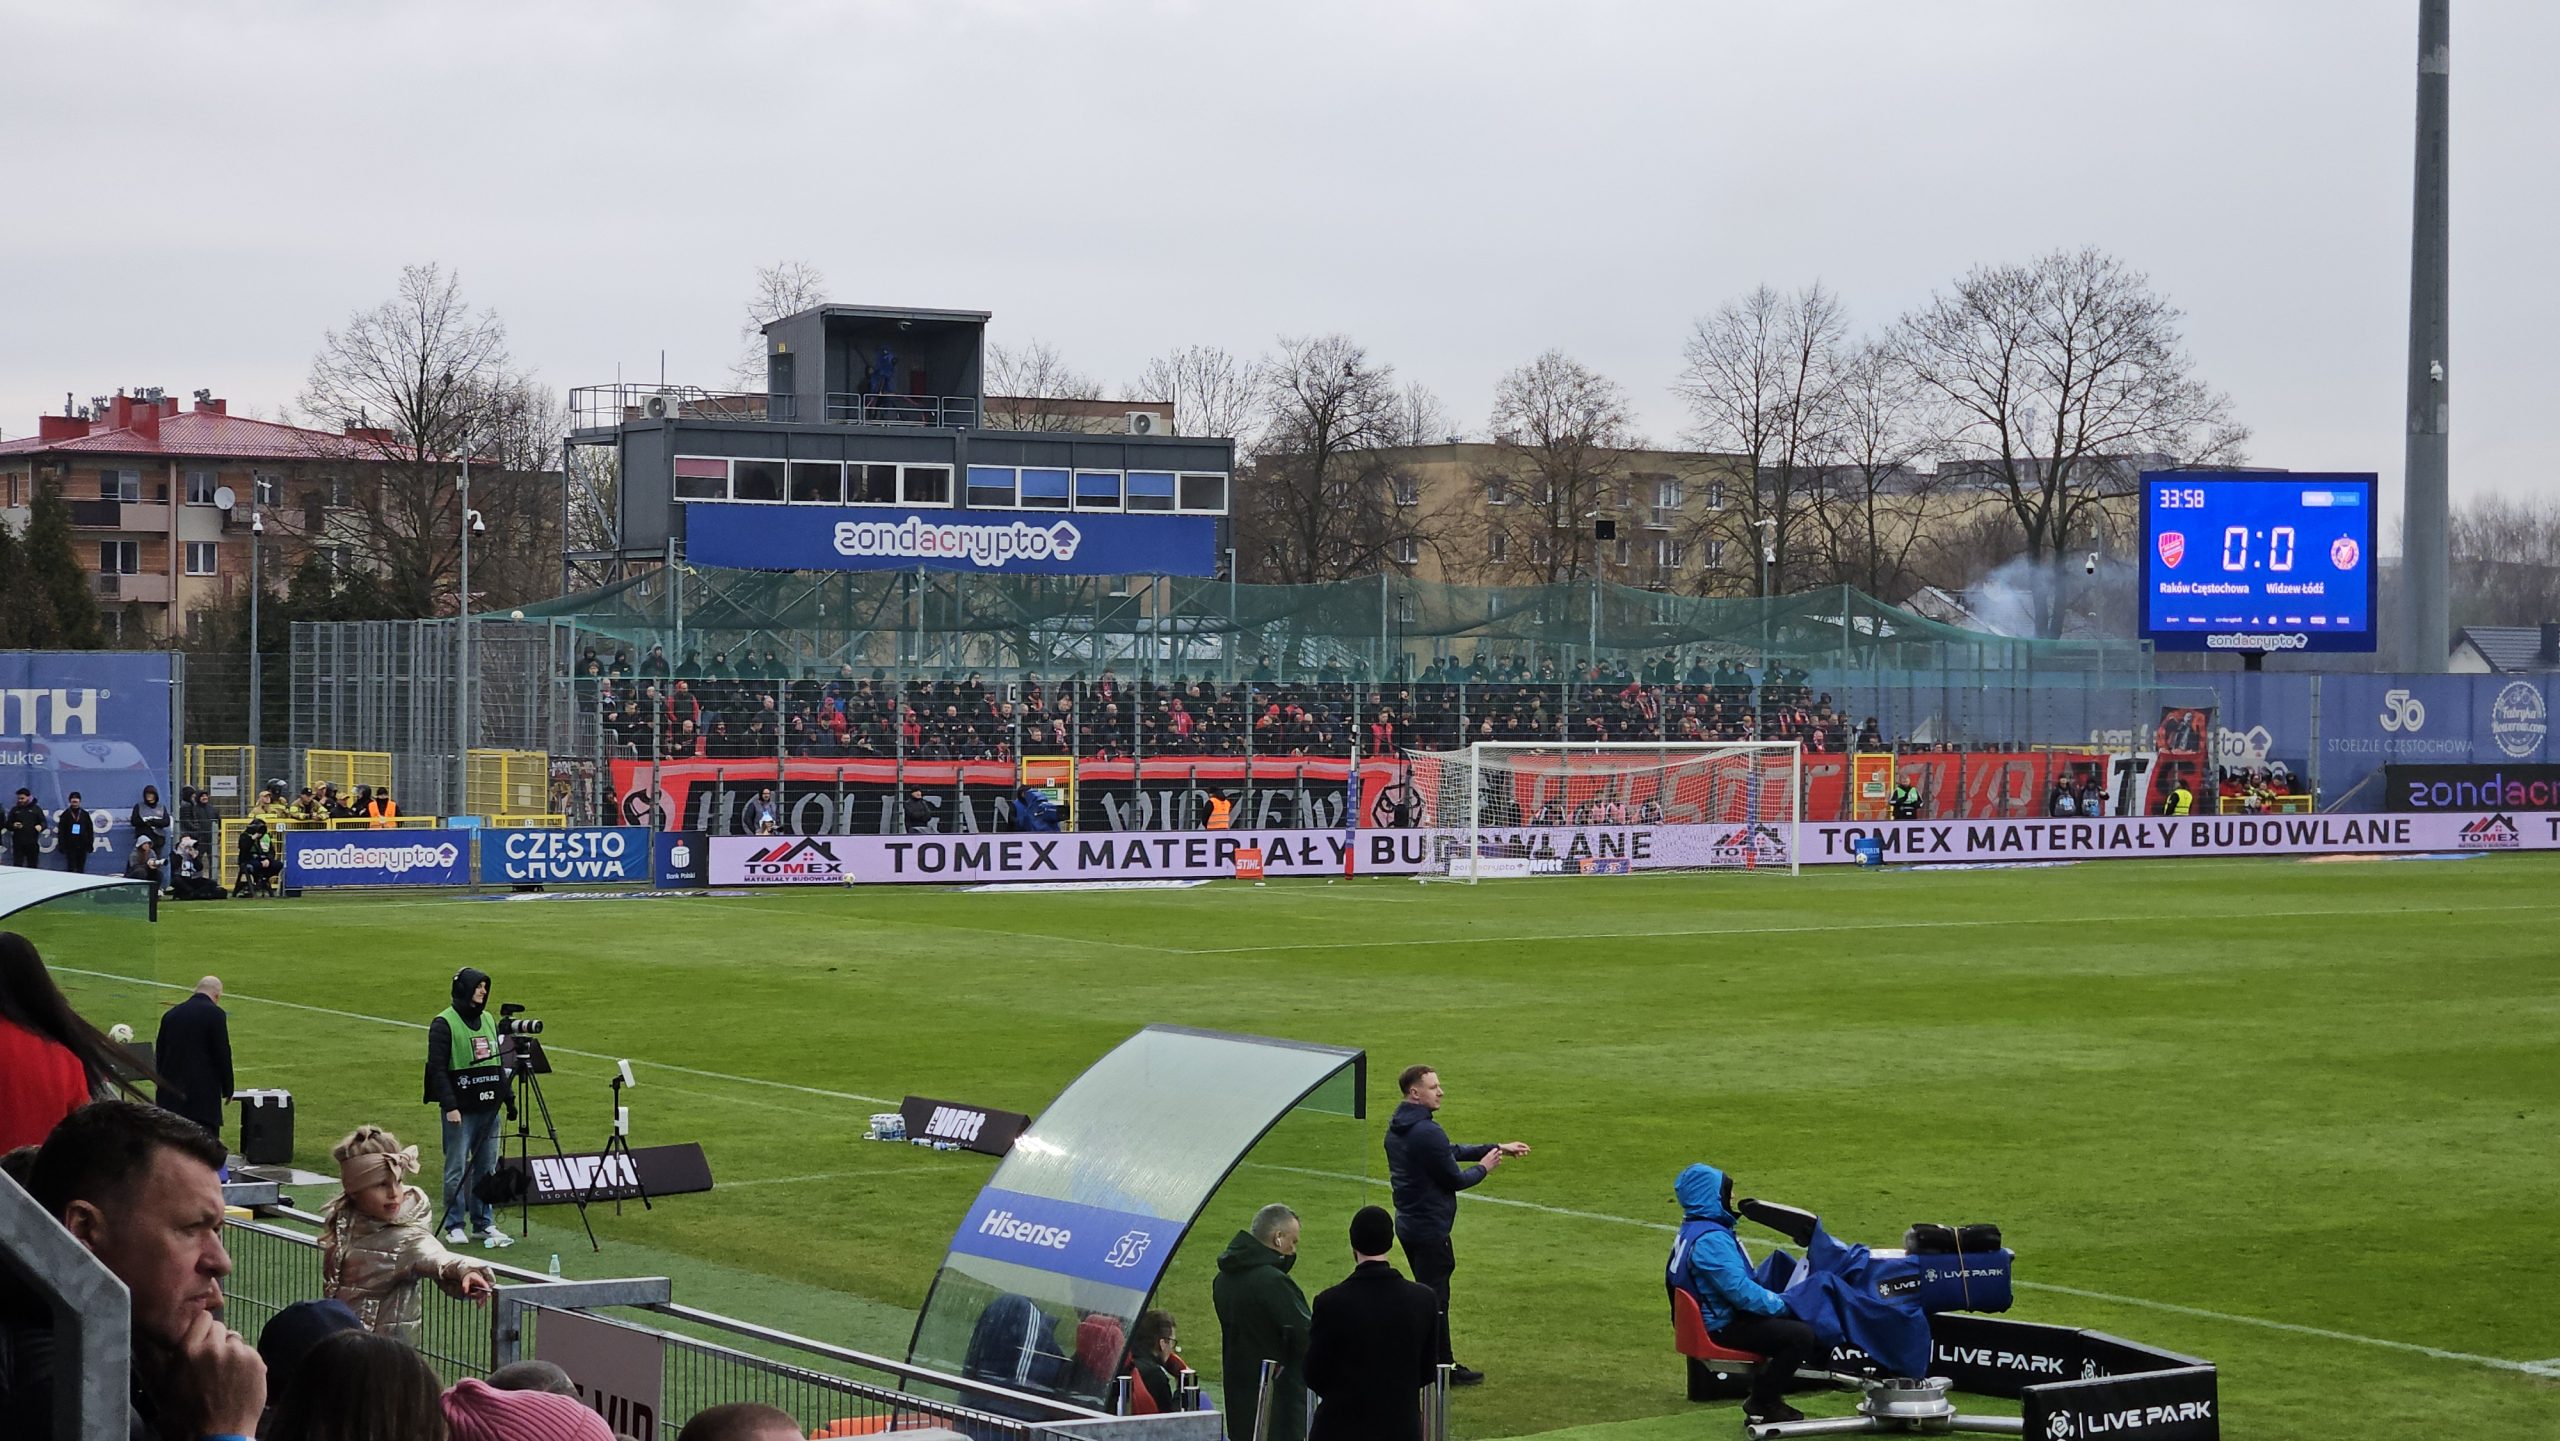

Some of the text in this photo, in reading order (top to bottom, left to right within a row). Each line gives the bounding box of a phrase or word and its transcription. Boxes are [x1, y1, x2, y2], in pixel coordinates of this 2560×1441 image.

[2160, 489, 2204, 508] 33:58
[838, 518, 1049, 562] zondacrypto
[2160, 581, 2249, 596] Raków Częstochowa
[2266, 581, 2324, 594] Widzew Łódź
[2208, 634, 2293, 649] zondacrypto
[2328, 739, 2474, 756] STOELZLE CZĘSTOCHOWA
[1819, 819, 2411, 855] TOMEX MATERIAŁY BUDOWLANE
[2458, 834, 2519, 842] TOMEX
[505, 832, 625, 862] CZĘSTO
[301, 844, 436, 870] zondacrypto
[885, 839, 1059, 874] TOMEX
[1236, 858, 1261, 870] STIHL
[744, 863, 842, 874] TOMEX
[479, 1091, 495, 1101] 062
[932, 1107, 986, 1142] Witt
[979, 1209, 1071, 1250] Hisense
[1944, 1268, 2004, 1279] LIVE PARK
[1894, 1281, 1916, 1290] LIVE
[1938, 1344, 2064, 1375] LIVE PARK
[2088, 1400, 2211, 1433] LIVE PARK
